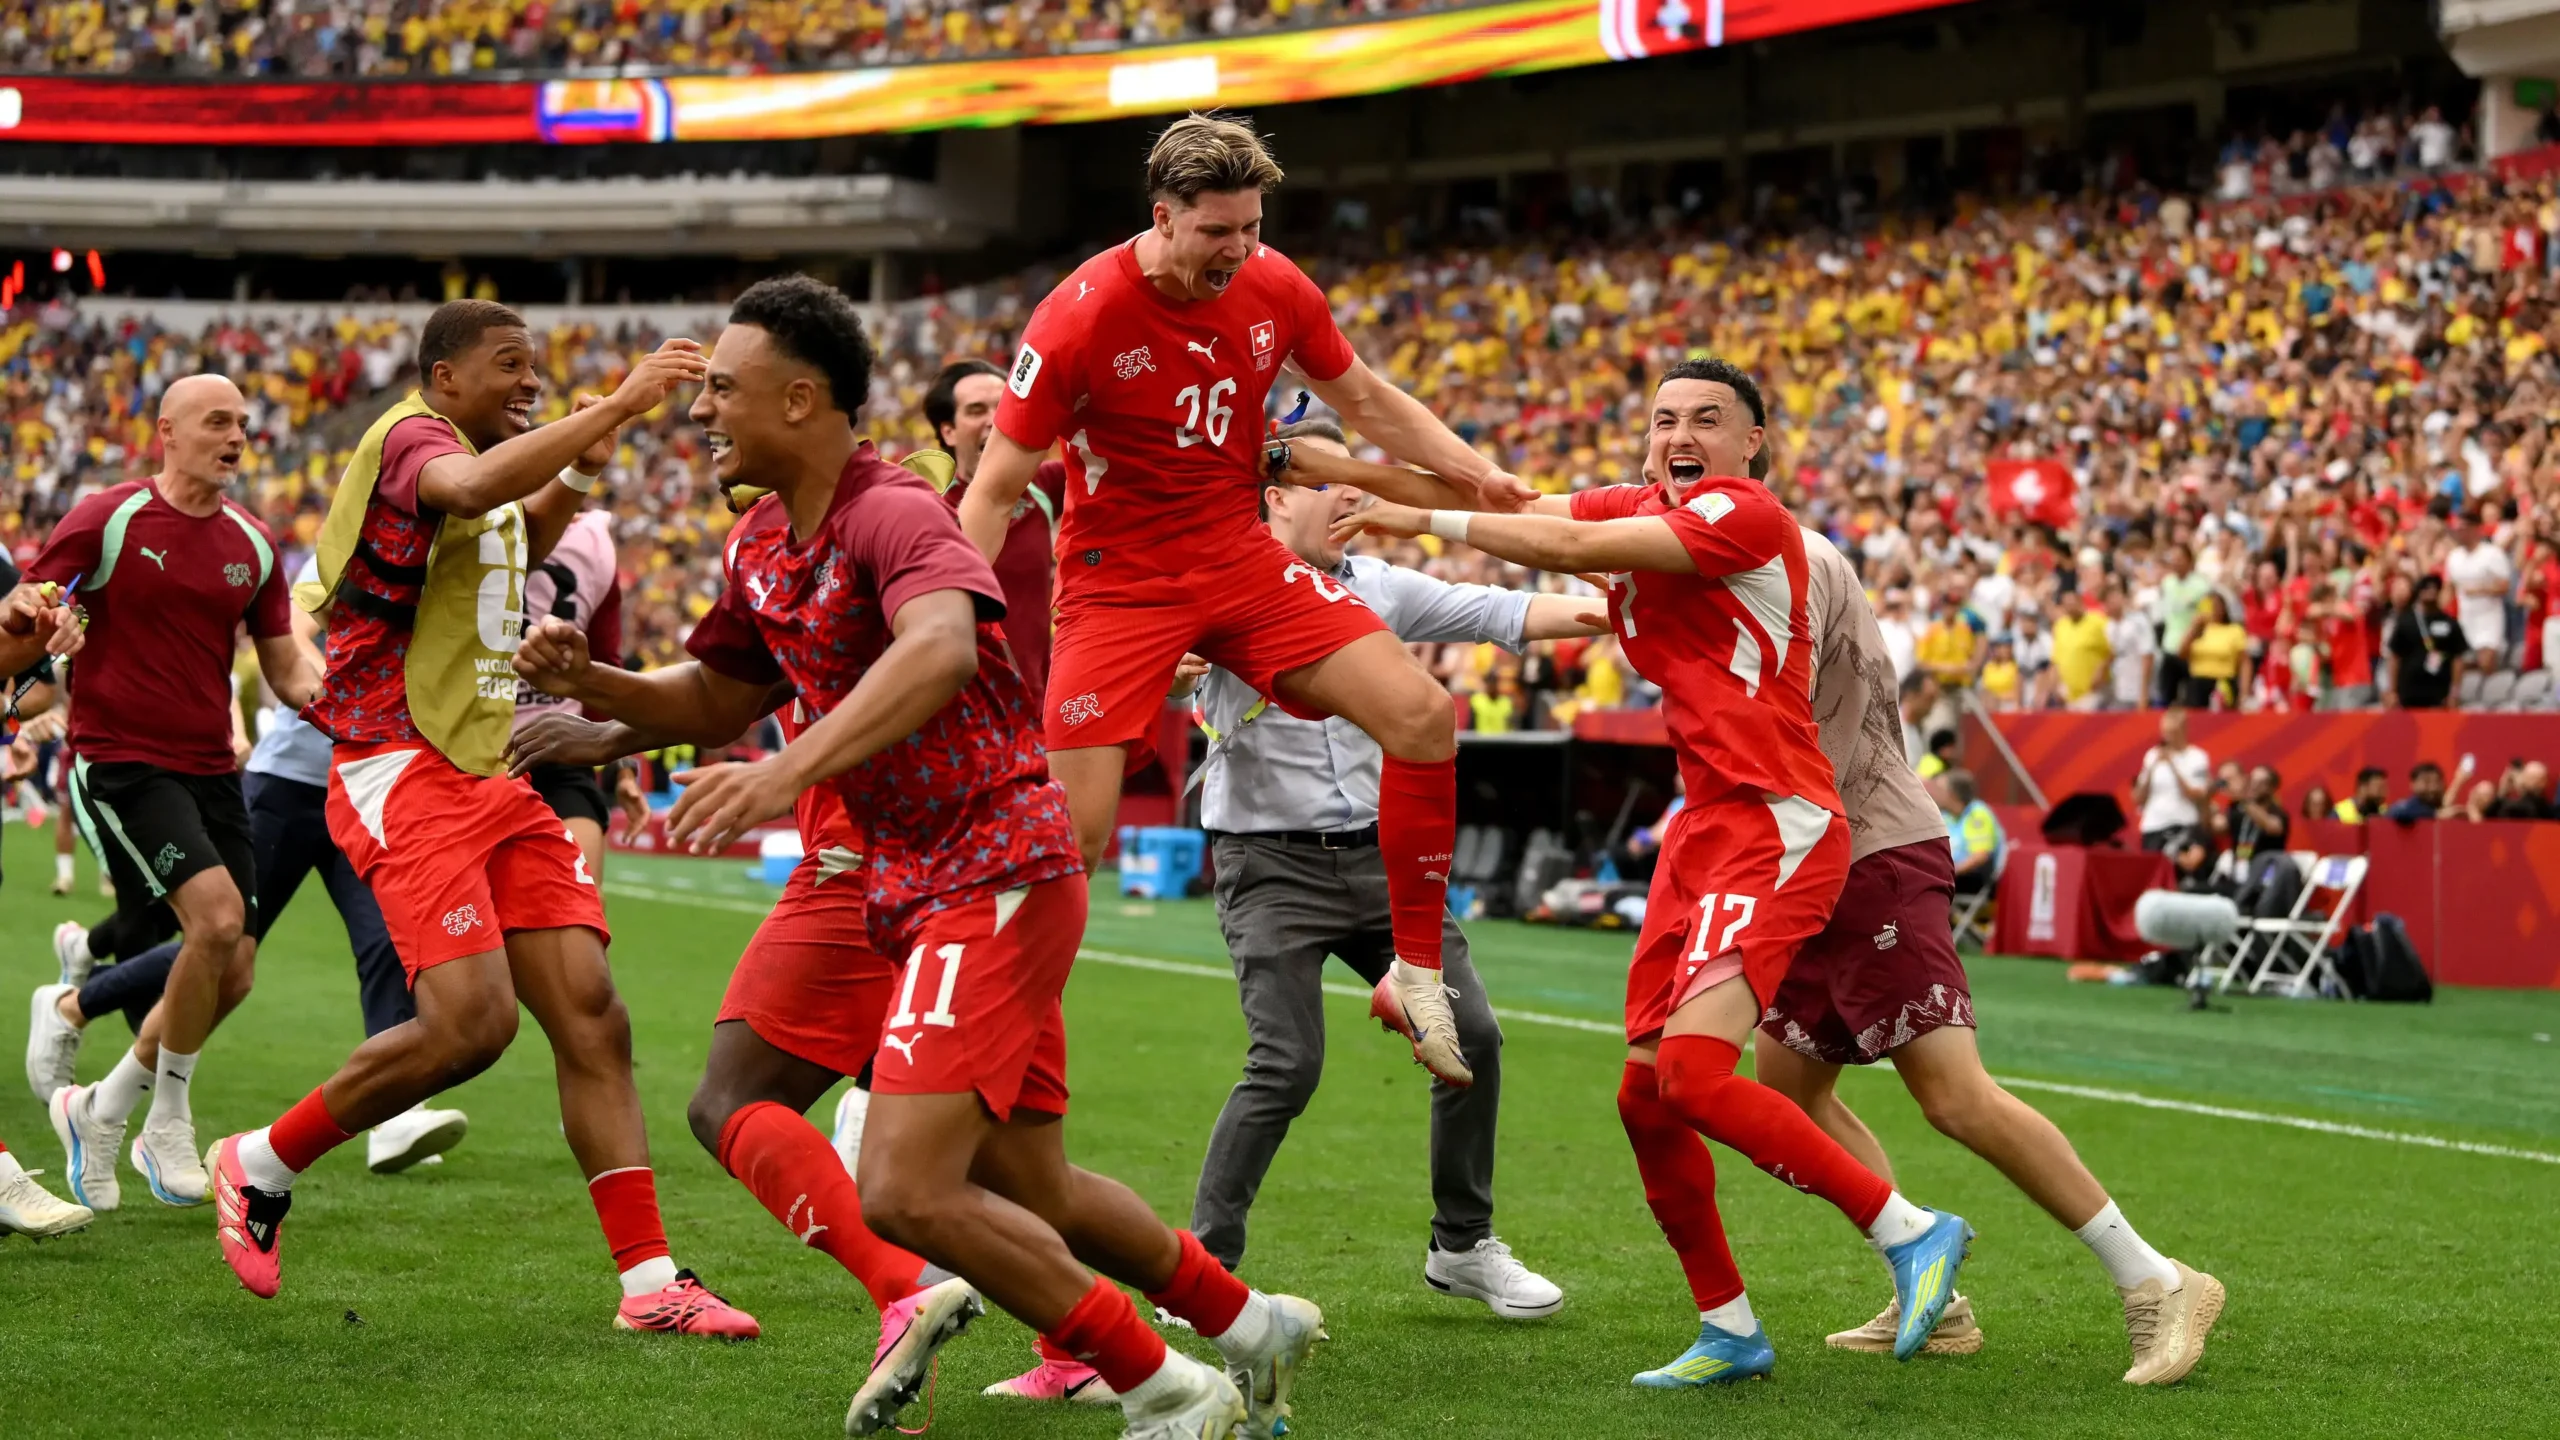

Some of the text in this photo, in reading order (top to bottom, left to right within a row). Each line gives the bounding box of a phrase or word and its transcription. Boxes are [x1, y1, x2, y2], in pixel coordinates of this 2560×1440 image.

[1175, 376, 1237, 449] 26
[1688, 893, 1758, 962] 17
[1873, 929, 1896, 944] PUMA
[888, 943, 966, 1029] 11
